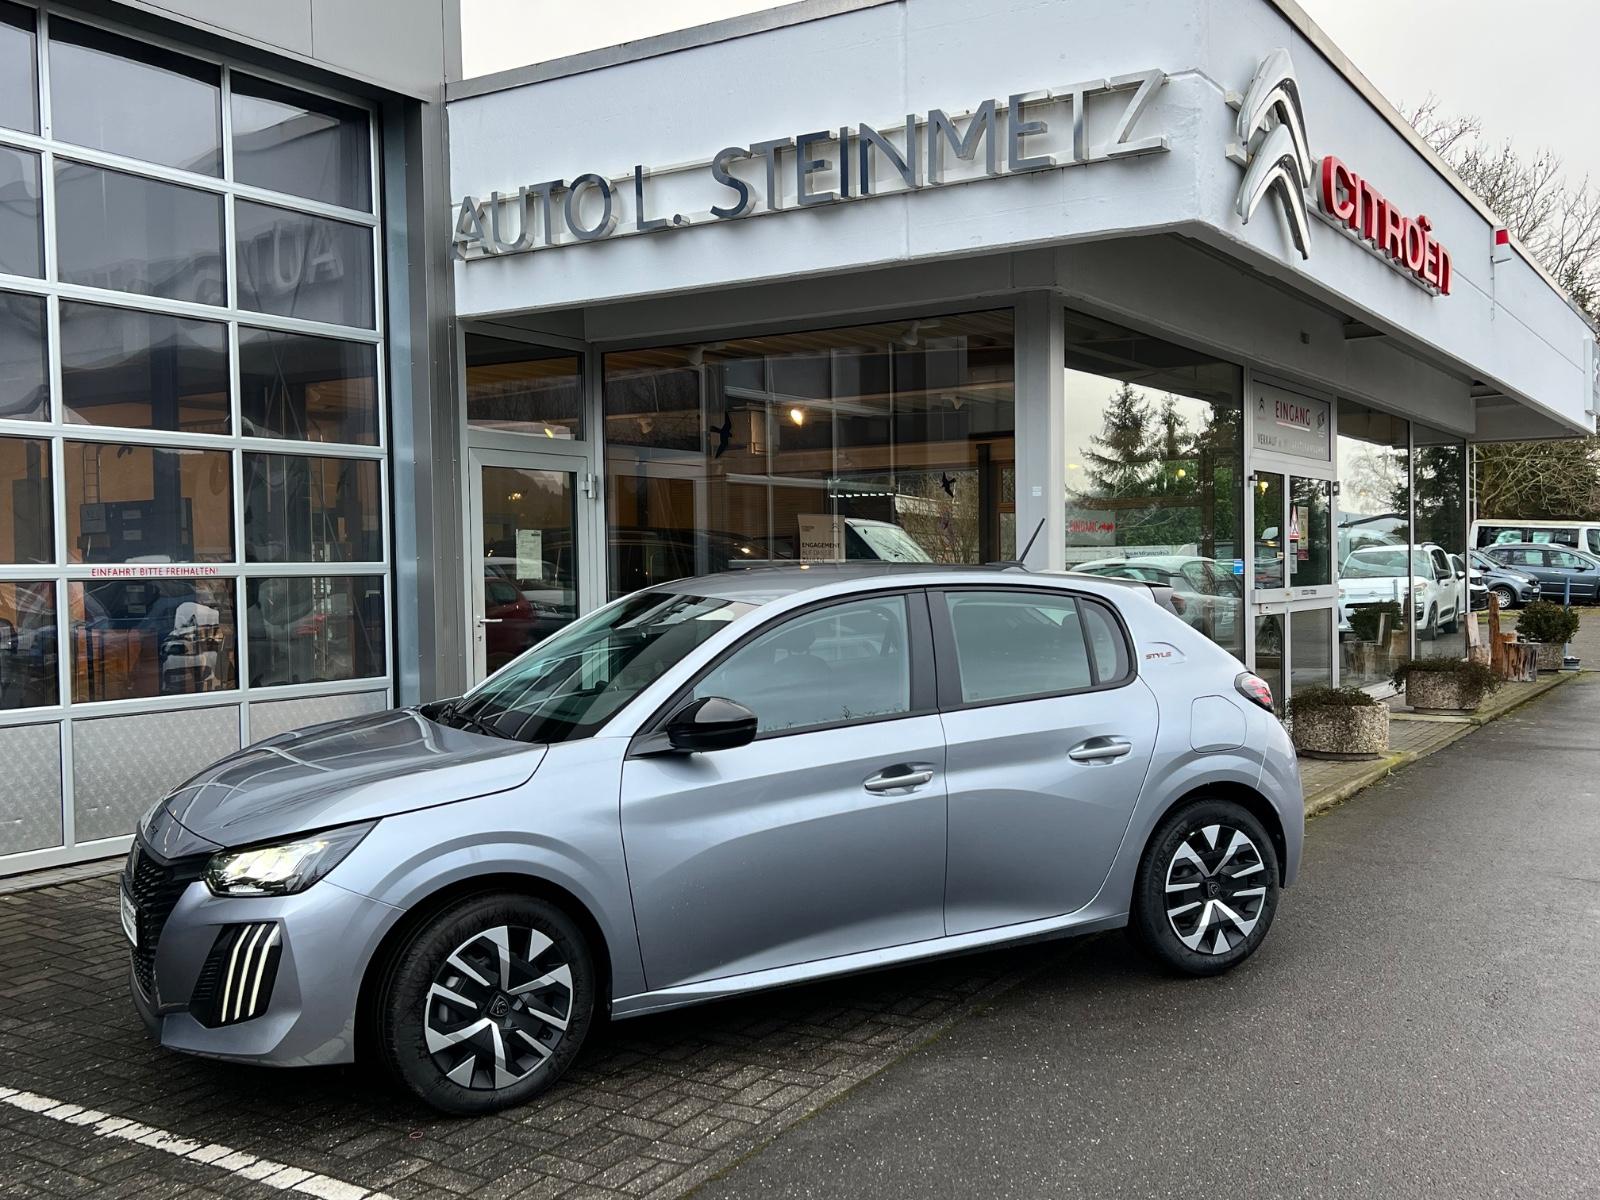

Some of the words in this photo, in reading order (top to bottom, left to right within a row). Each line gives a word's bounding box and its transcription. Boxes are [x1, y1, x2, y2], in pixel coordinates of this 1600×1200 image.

[452, 173, 619, 254] AUTO
[634, 165, 690, 231] L.
[710, 68, 1168, 218] STEINMETZ
[1275, 400, 1311, 426] EINGANG
[91, 568, 136, 577] EINFAHRT
[140, 567, 162, 576] BITTE
[166, 567, 219, 576] FREIHALTEN!
[1145, 651, 1172, 660] STYLE
